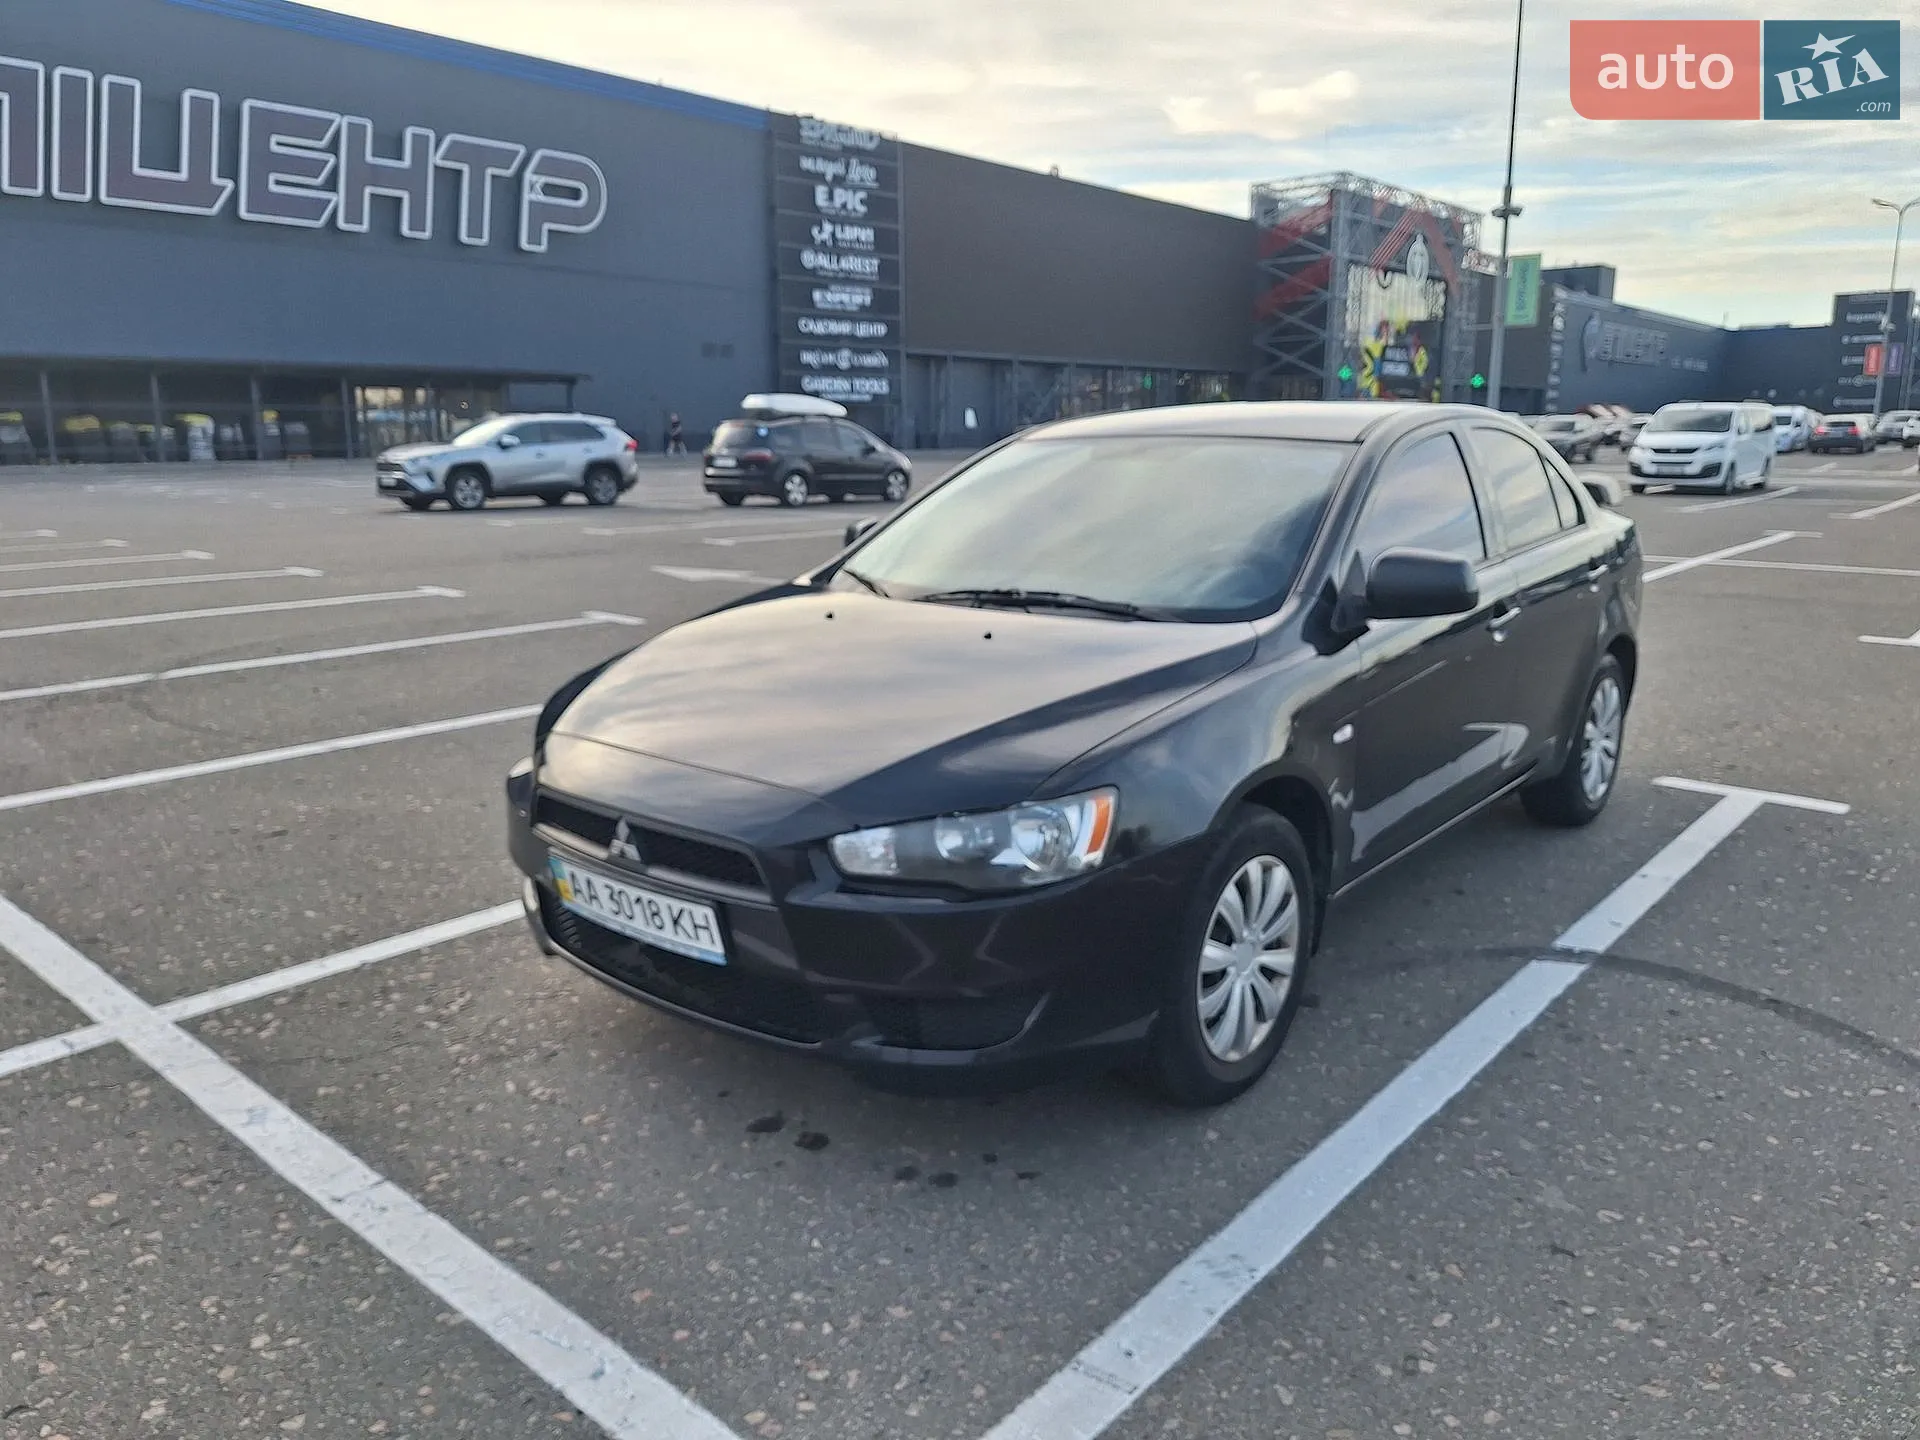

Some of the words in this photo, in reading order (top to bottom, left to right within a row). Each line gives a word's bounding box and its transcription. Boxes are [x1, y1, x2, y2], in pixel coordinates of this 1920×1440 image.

[570, 870, 603, 910] AA
[604, 883, 665, 931] 3018
[667, 902, 716, 946] KH
